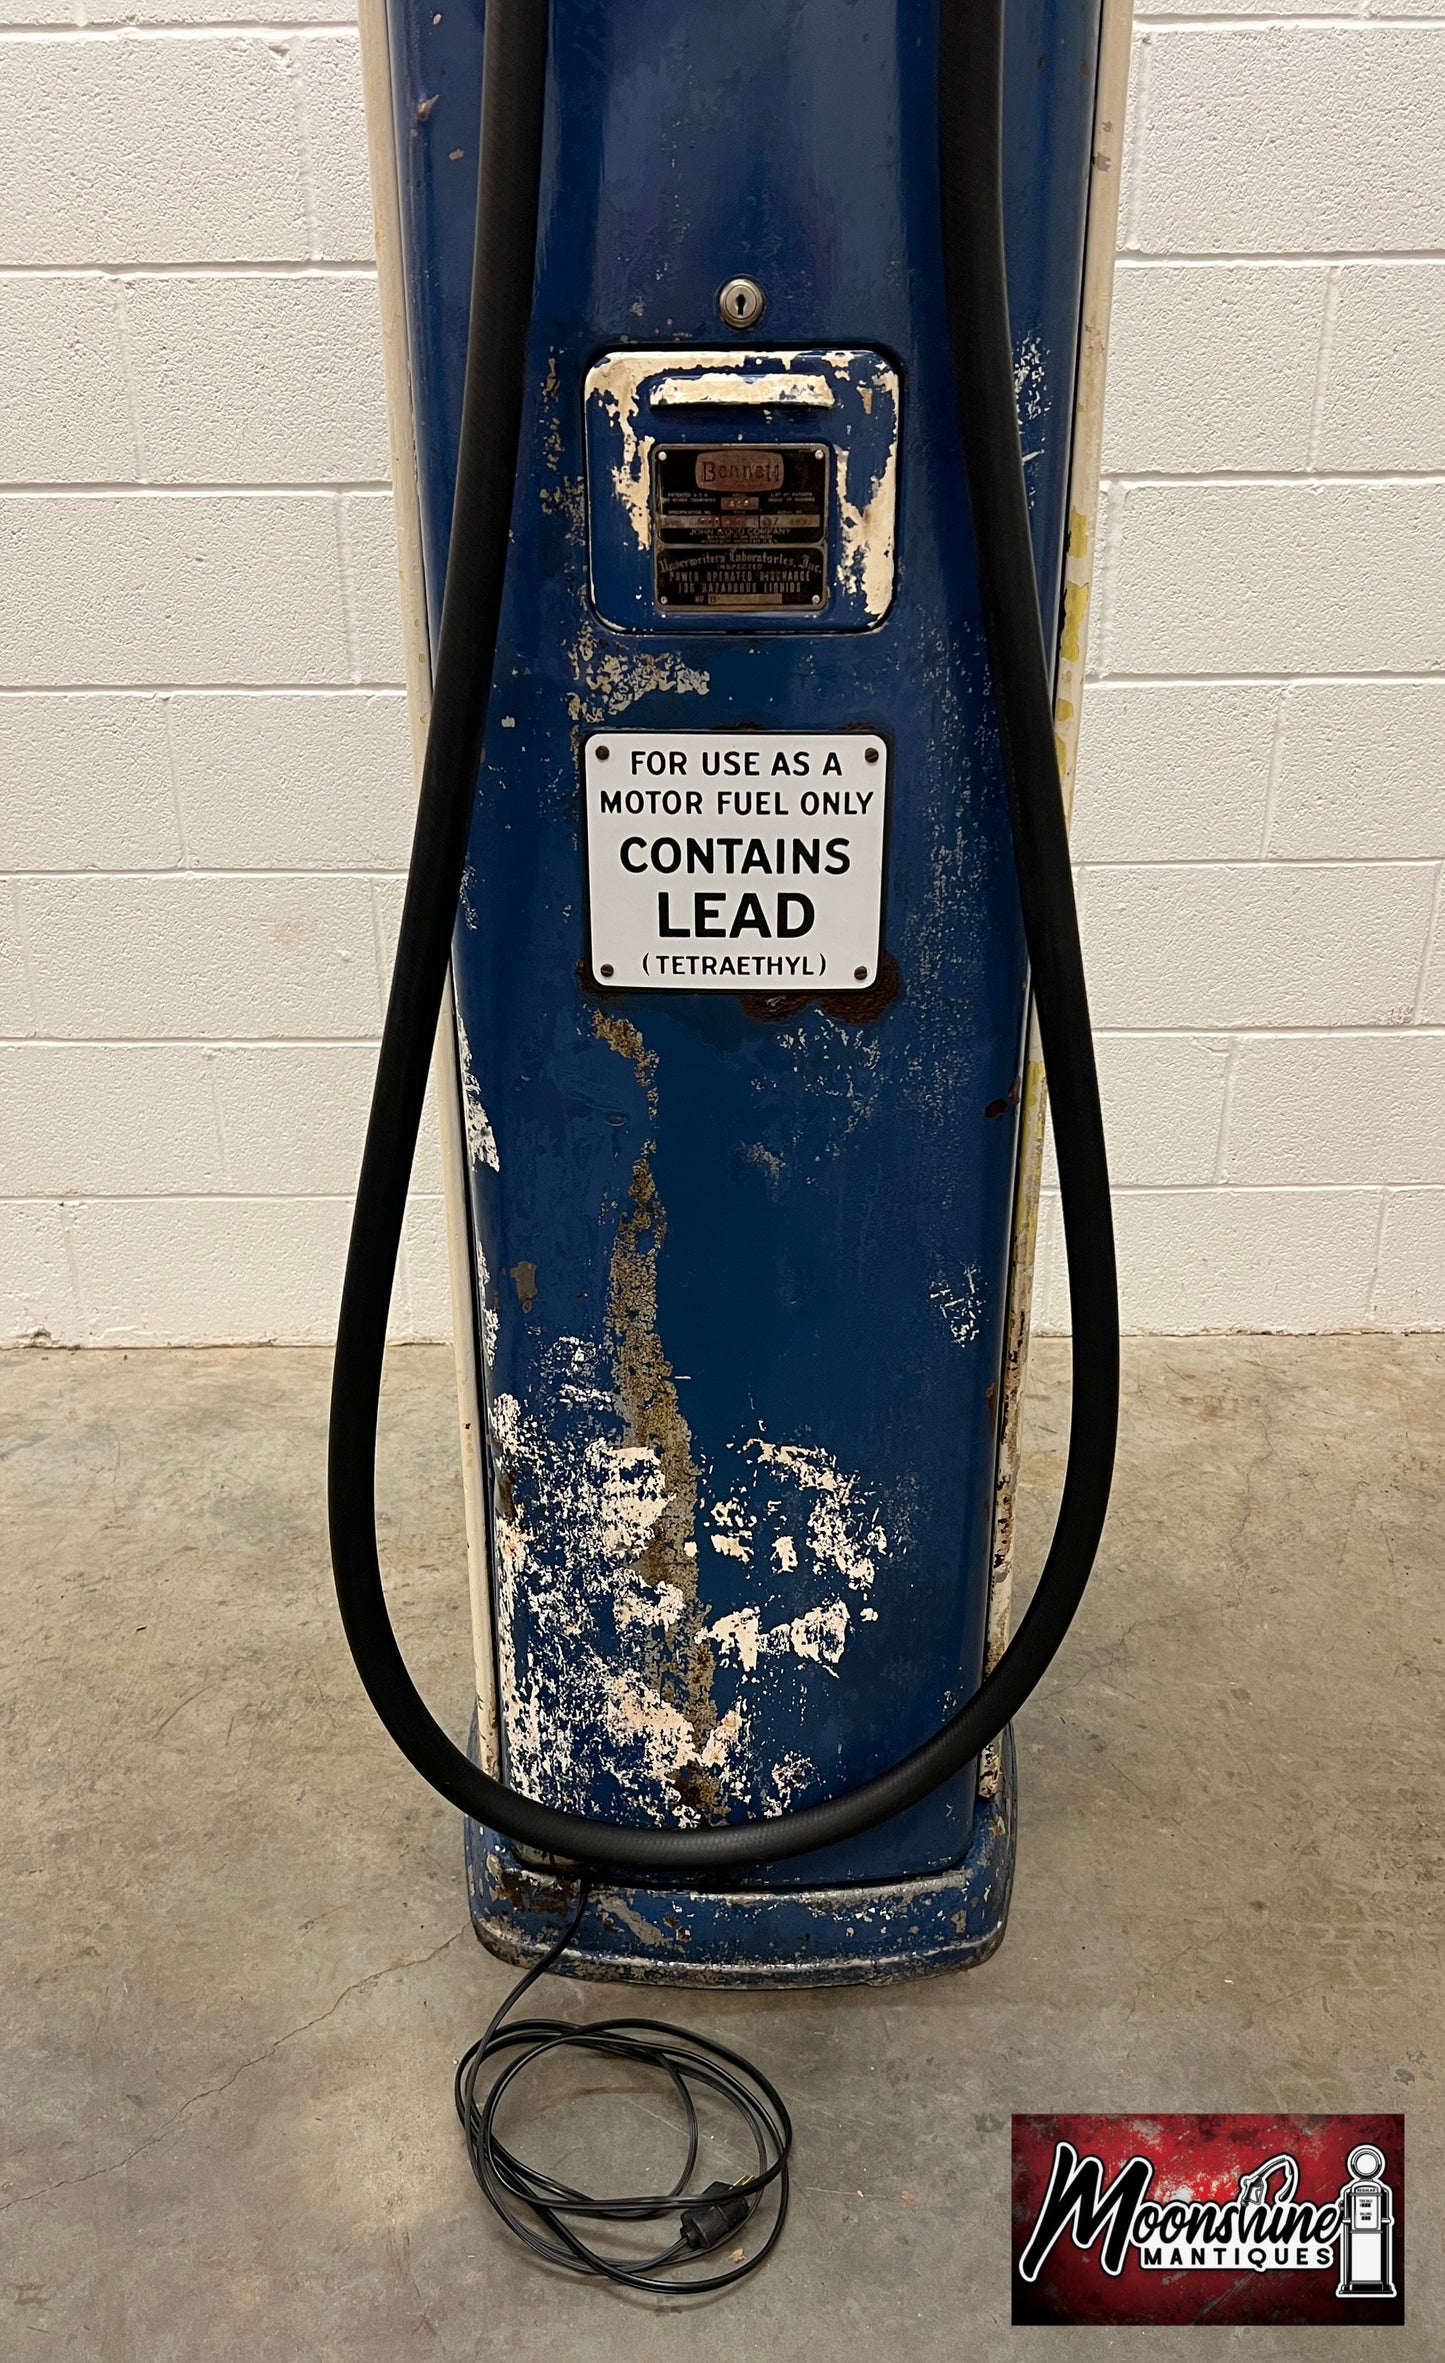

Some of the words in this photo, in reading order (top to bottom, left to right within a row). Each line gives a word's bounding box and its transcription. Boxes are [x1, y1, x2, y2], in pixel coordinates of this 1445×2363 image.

[703, 461, 781, 483] Bennett
[747, 527, 791, 535] COMPANY
[669, 570, 699, 582] POWER
[706, 570, 752, 582] OPERATED
[759, 570, 811, 582] DISCHARGE
[701, 582, 757, 593] HAZARDOUS
[763, 582, 801, 593] LIQUIDS
[631, 751, 688, 776] FOR
[702, 752, 760, 776] USE
[771, 752, 810, 776] AS
[822, 752, 843, 776] A
[600, 790, 703, 815] MOTOR
[717, 791, 789, 815] FUEL
[800, 791, 874, 815] ONLY
[620, 836, 851, 875] CONTAINS
[658, 892, 815, 938] LEAD
[642, 953, 827, 976] (TETRAETHYL)
